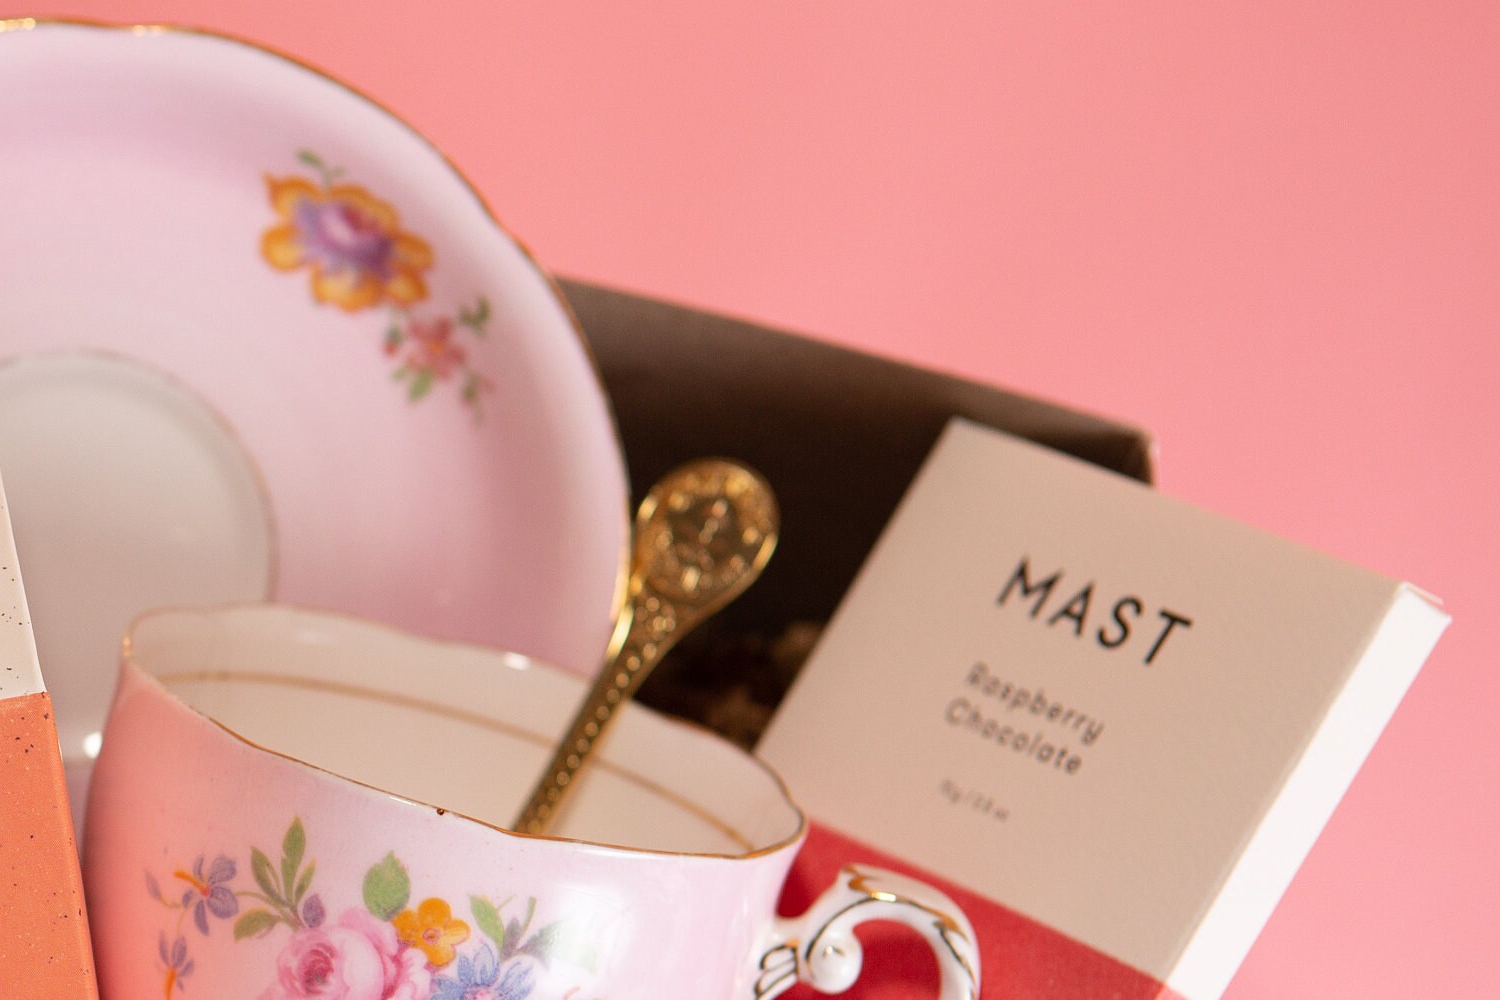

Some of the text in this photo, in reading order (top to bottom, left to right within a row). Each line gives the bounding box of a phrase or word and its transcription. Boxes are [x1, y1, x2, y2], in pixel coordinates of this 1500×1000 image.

[996, 555, 1193, 665] MAST
[946, 698, 1082, 774] Chocolate
[967, 661, 1104, 746] Raspberry
